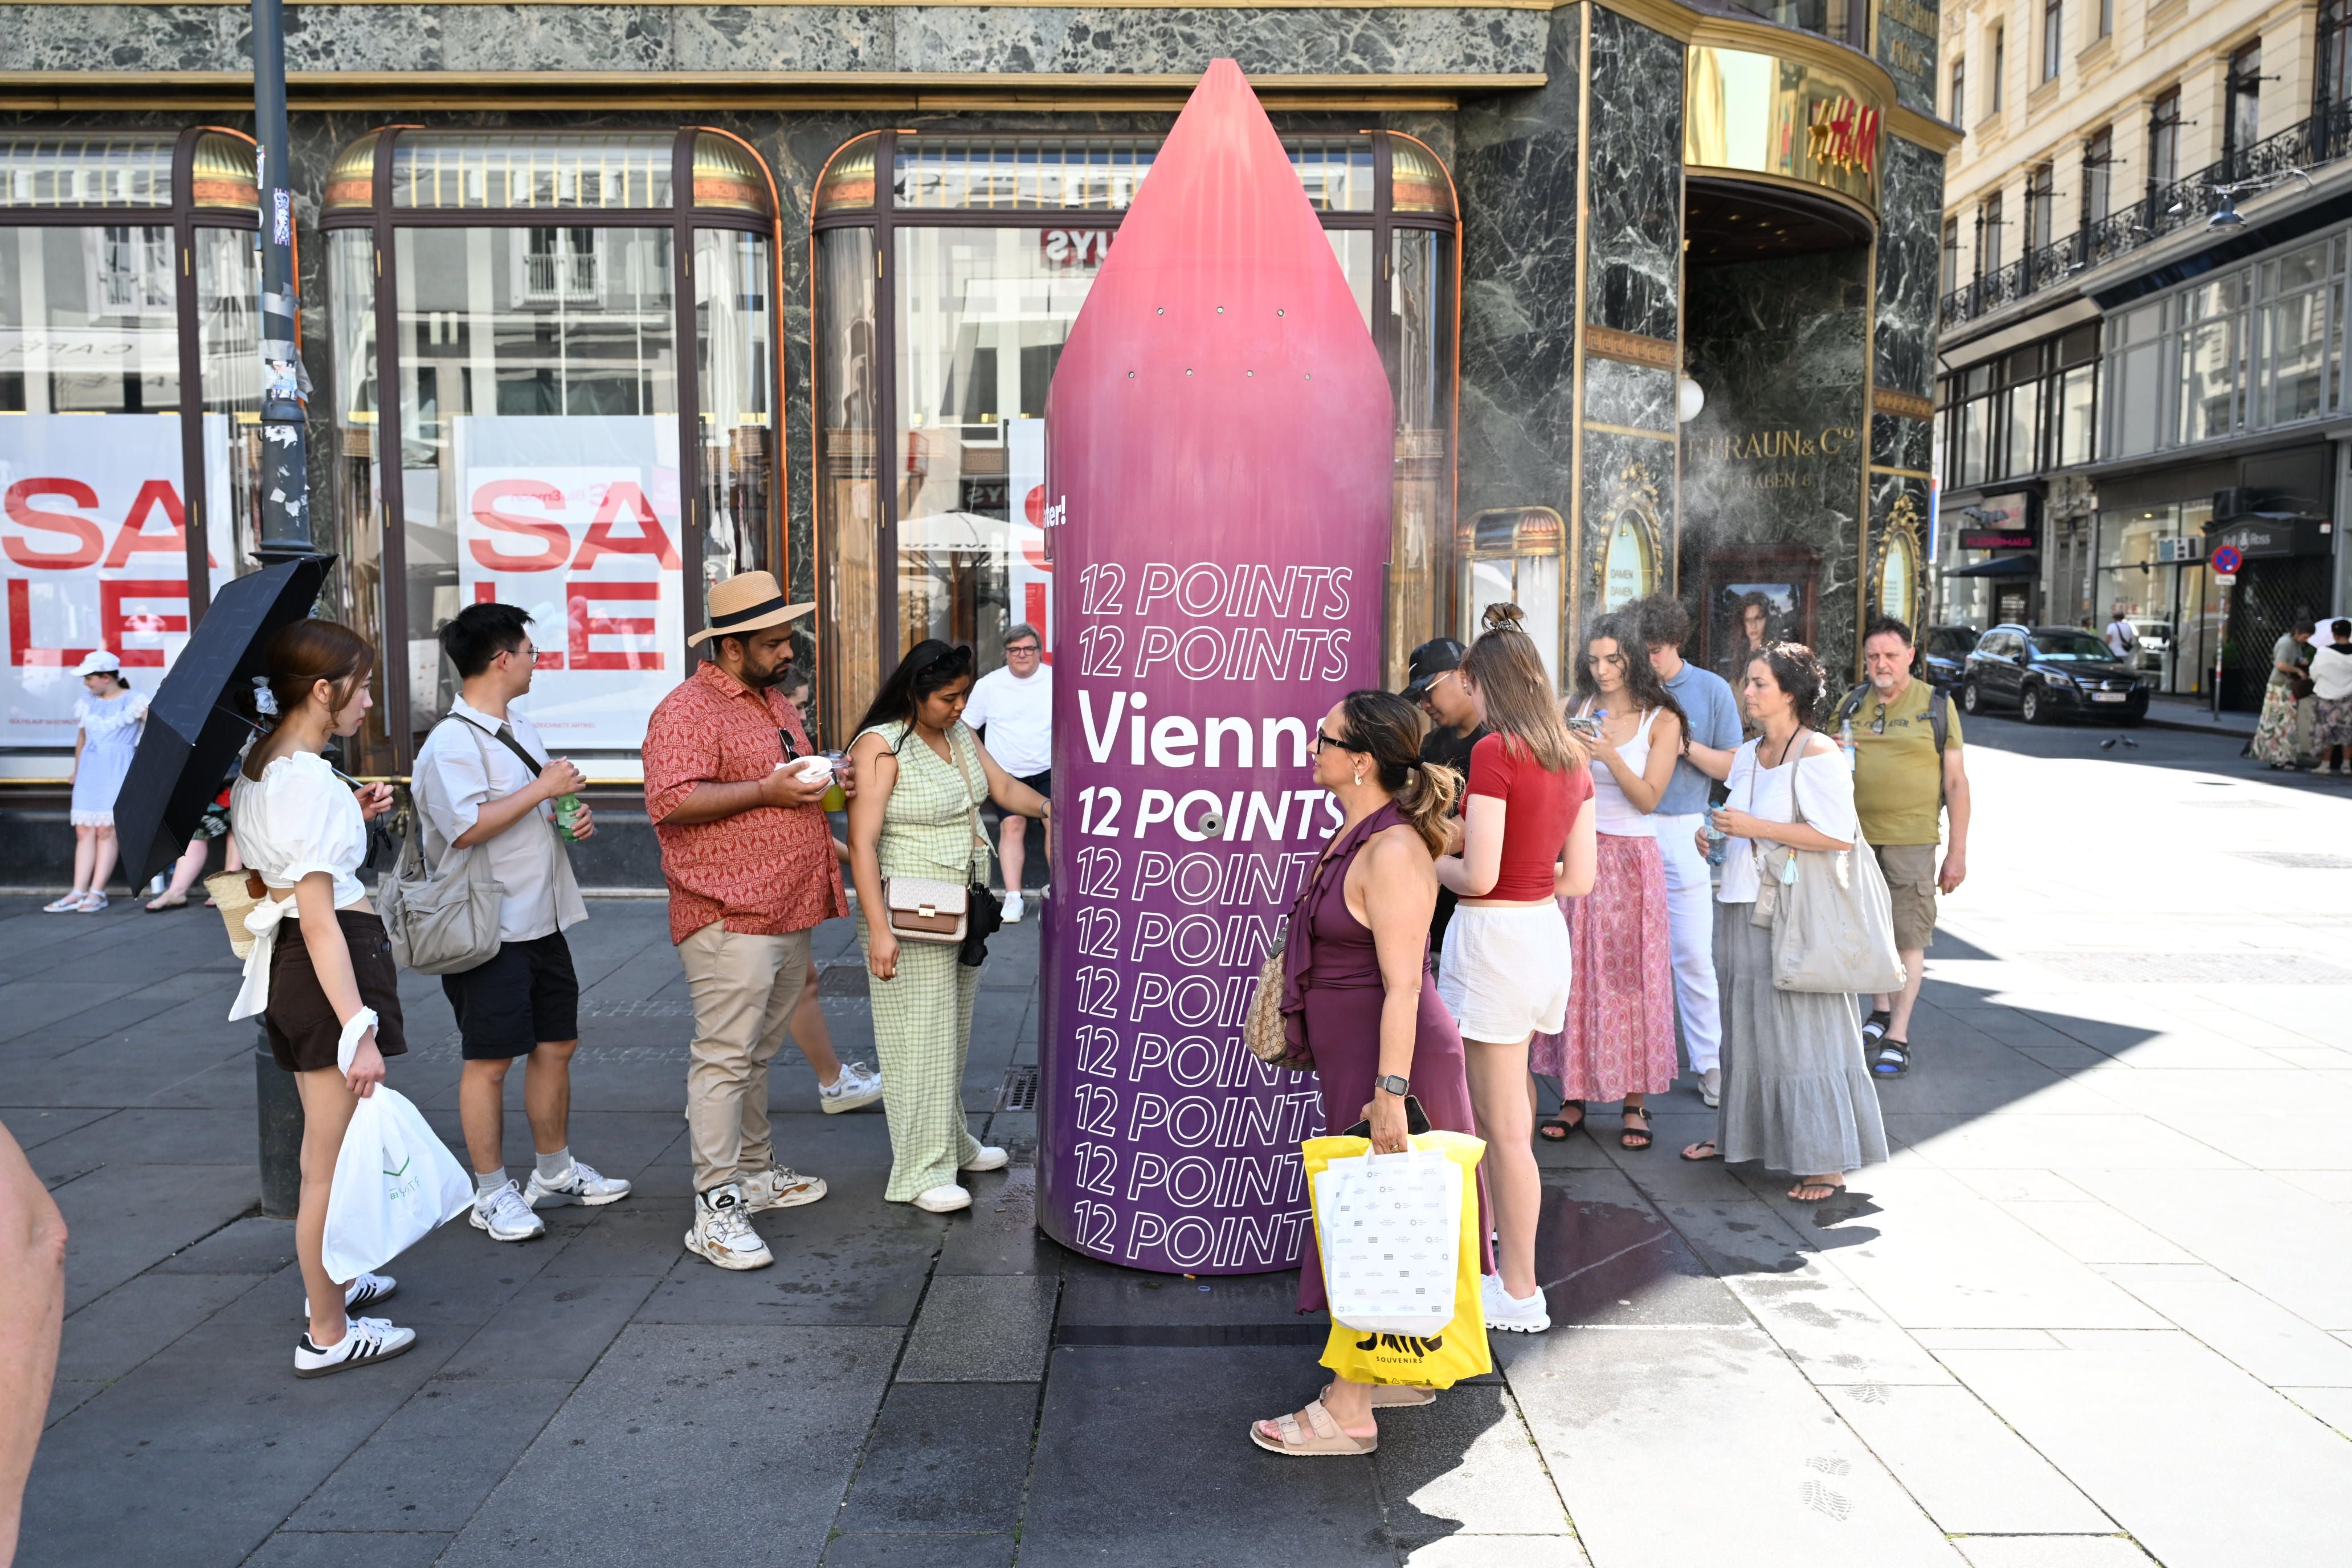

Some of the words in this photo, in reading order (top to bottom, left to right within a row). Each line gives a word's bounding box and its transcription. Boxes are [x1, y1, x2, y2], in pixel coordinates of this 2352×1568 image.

[1080, 563, 1126, 615] 12
[1136, 562, 1353, 620] POINTS
[1611, 569, 1634, 579] DAMEN
[1079, 625, 1125, 677] 12
[1134, 626, 1351, 682] POINTS
[1078, 689, 1325, 768] Vienn
[1078, 786, 1122, 838] 12
[1134, 789, 1345, 843] POINTS
[1077, 846, 1122, 899] 12
[1132, 851, 1319, 906] POINT
[1076, 906, 1121, 959] 12
[1131, 911, 1288, 967] POIN
[1076, 965, 1120, 1019] 12
[1130, 972, 1255, 1027] POI
[1076, 1024, 1119, 1078] 12
[1129, 1032, 1320, 1088] POIN
[1075, 1083, 1118, 1137] 12
[1075, 1142, 1118, 1196] 12
[1127, 1151, 1304, 1207] POINT
[1074, 1200, 1117, 1254] 12
[1126, 1208, 1313, 1267] POINT
